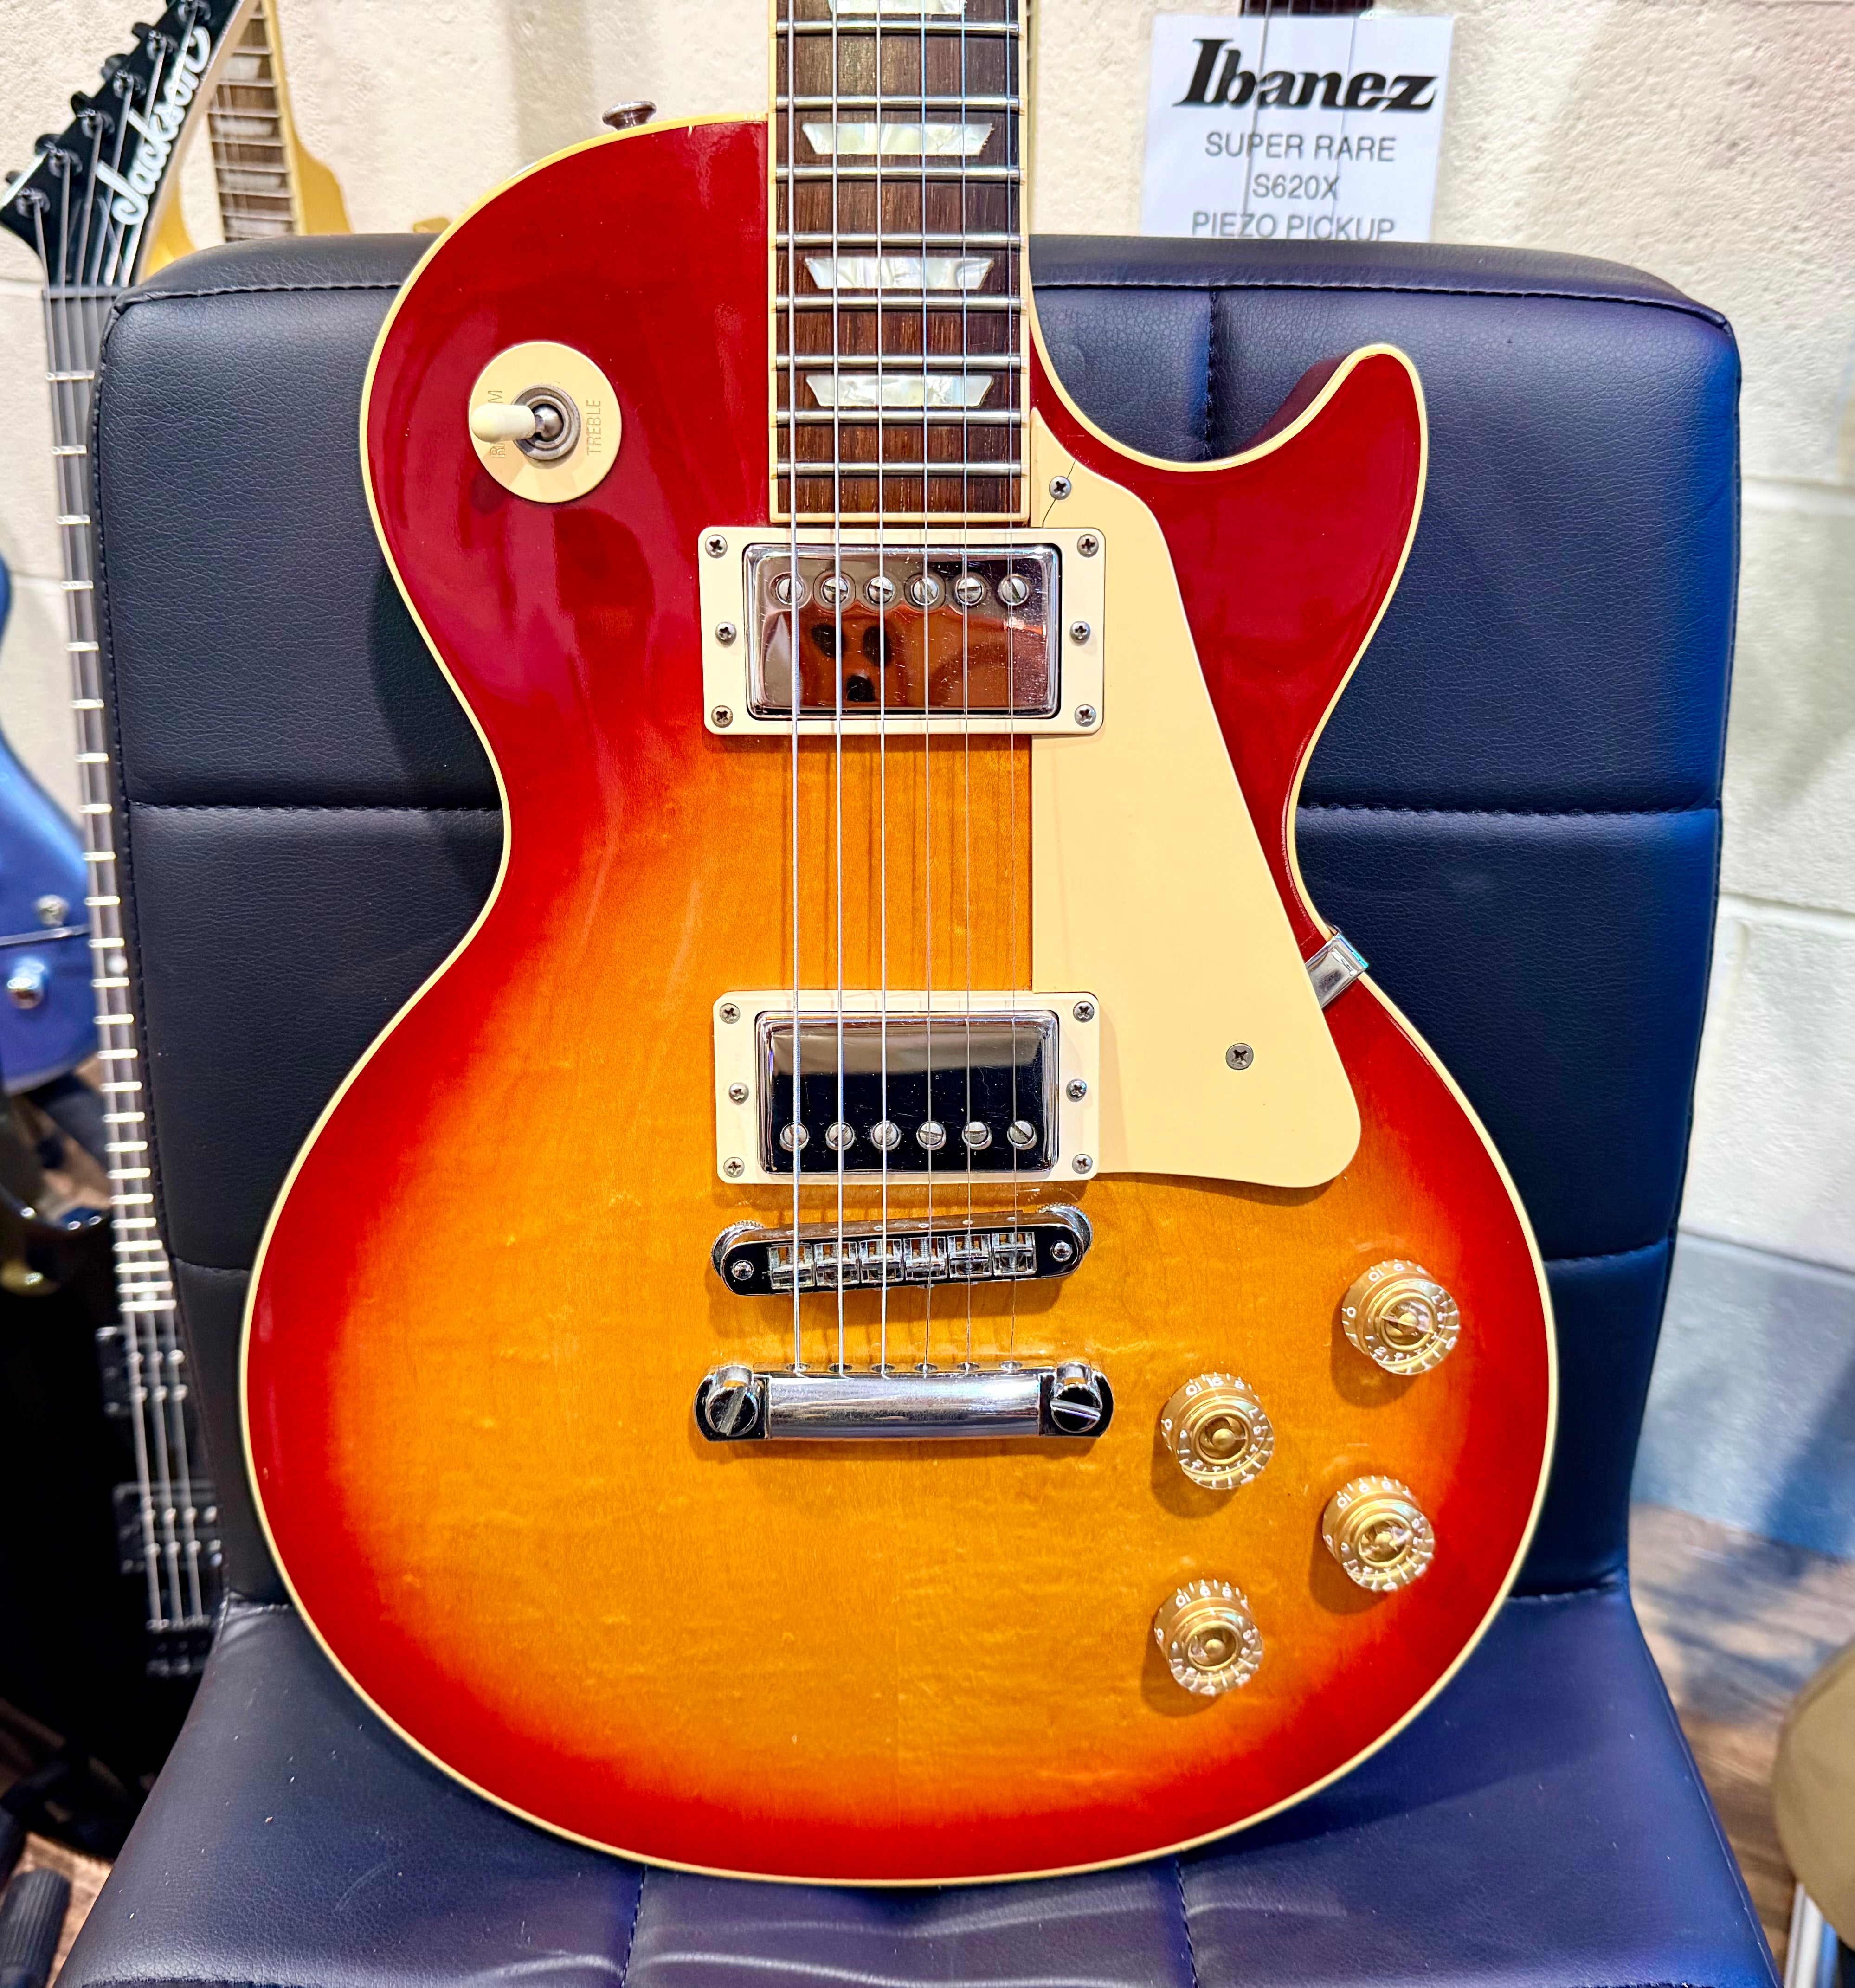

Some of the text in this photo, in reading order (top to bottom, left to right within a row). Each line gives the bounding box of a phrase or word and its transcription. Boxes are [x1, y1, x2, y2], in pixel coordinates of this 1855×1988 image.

[1172, 38, 1438, 113] Ibanez
[97, 26, 211, 226] Jackson
[1205, 131, 1397, 162] SUPER RARE
[1252, 173, 1340, 200] S620X
[1192, 210, 1396, 241] PIEZO PICKUP
[586, 400, 602, 456] TREBLE
